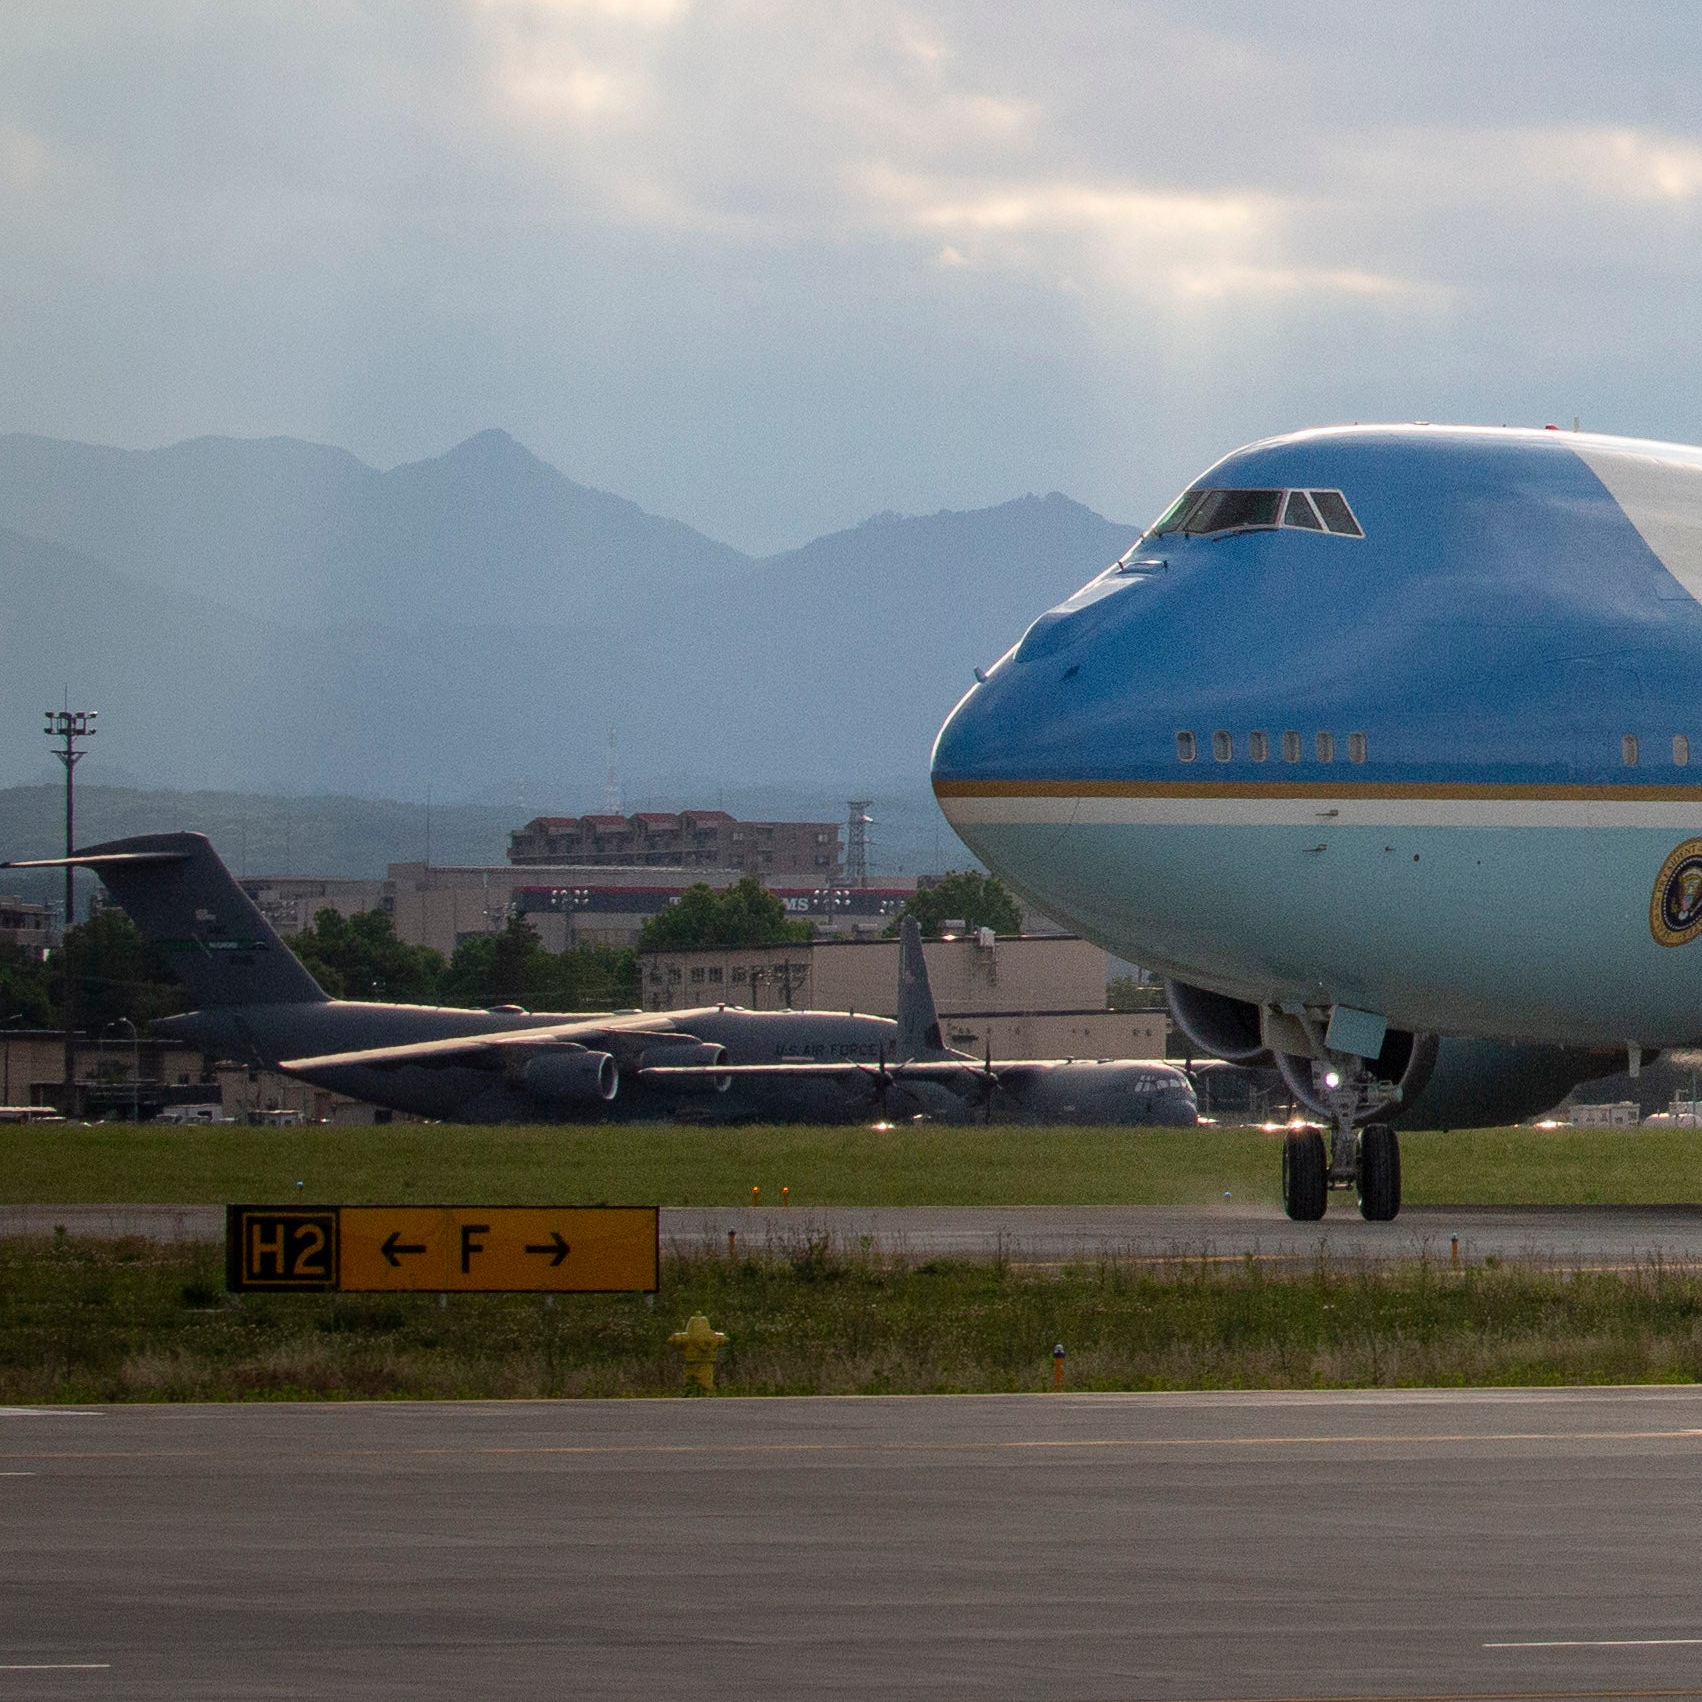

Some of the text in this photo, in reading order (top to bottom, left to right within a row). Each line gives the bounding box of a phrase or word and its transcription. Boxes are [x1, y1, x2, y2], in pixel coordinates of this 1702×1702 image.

[830, 1043, 878, 1056] FORCE
[252, 1223, 490, 1275] H2 F
